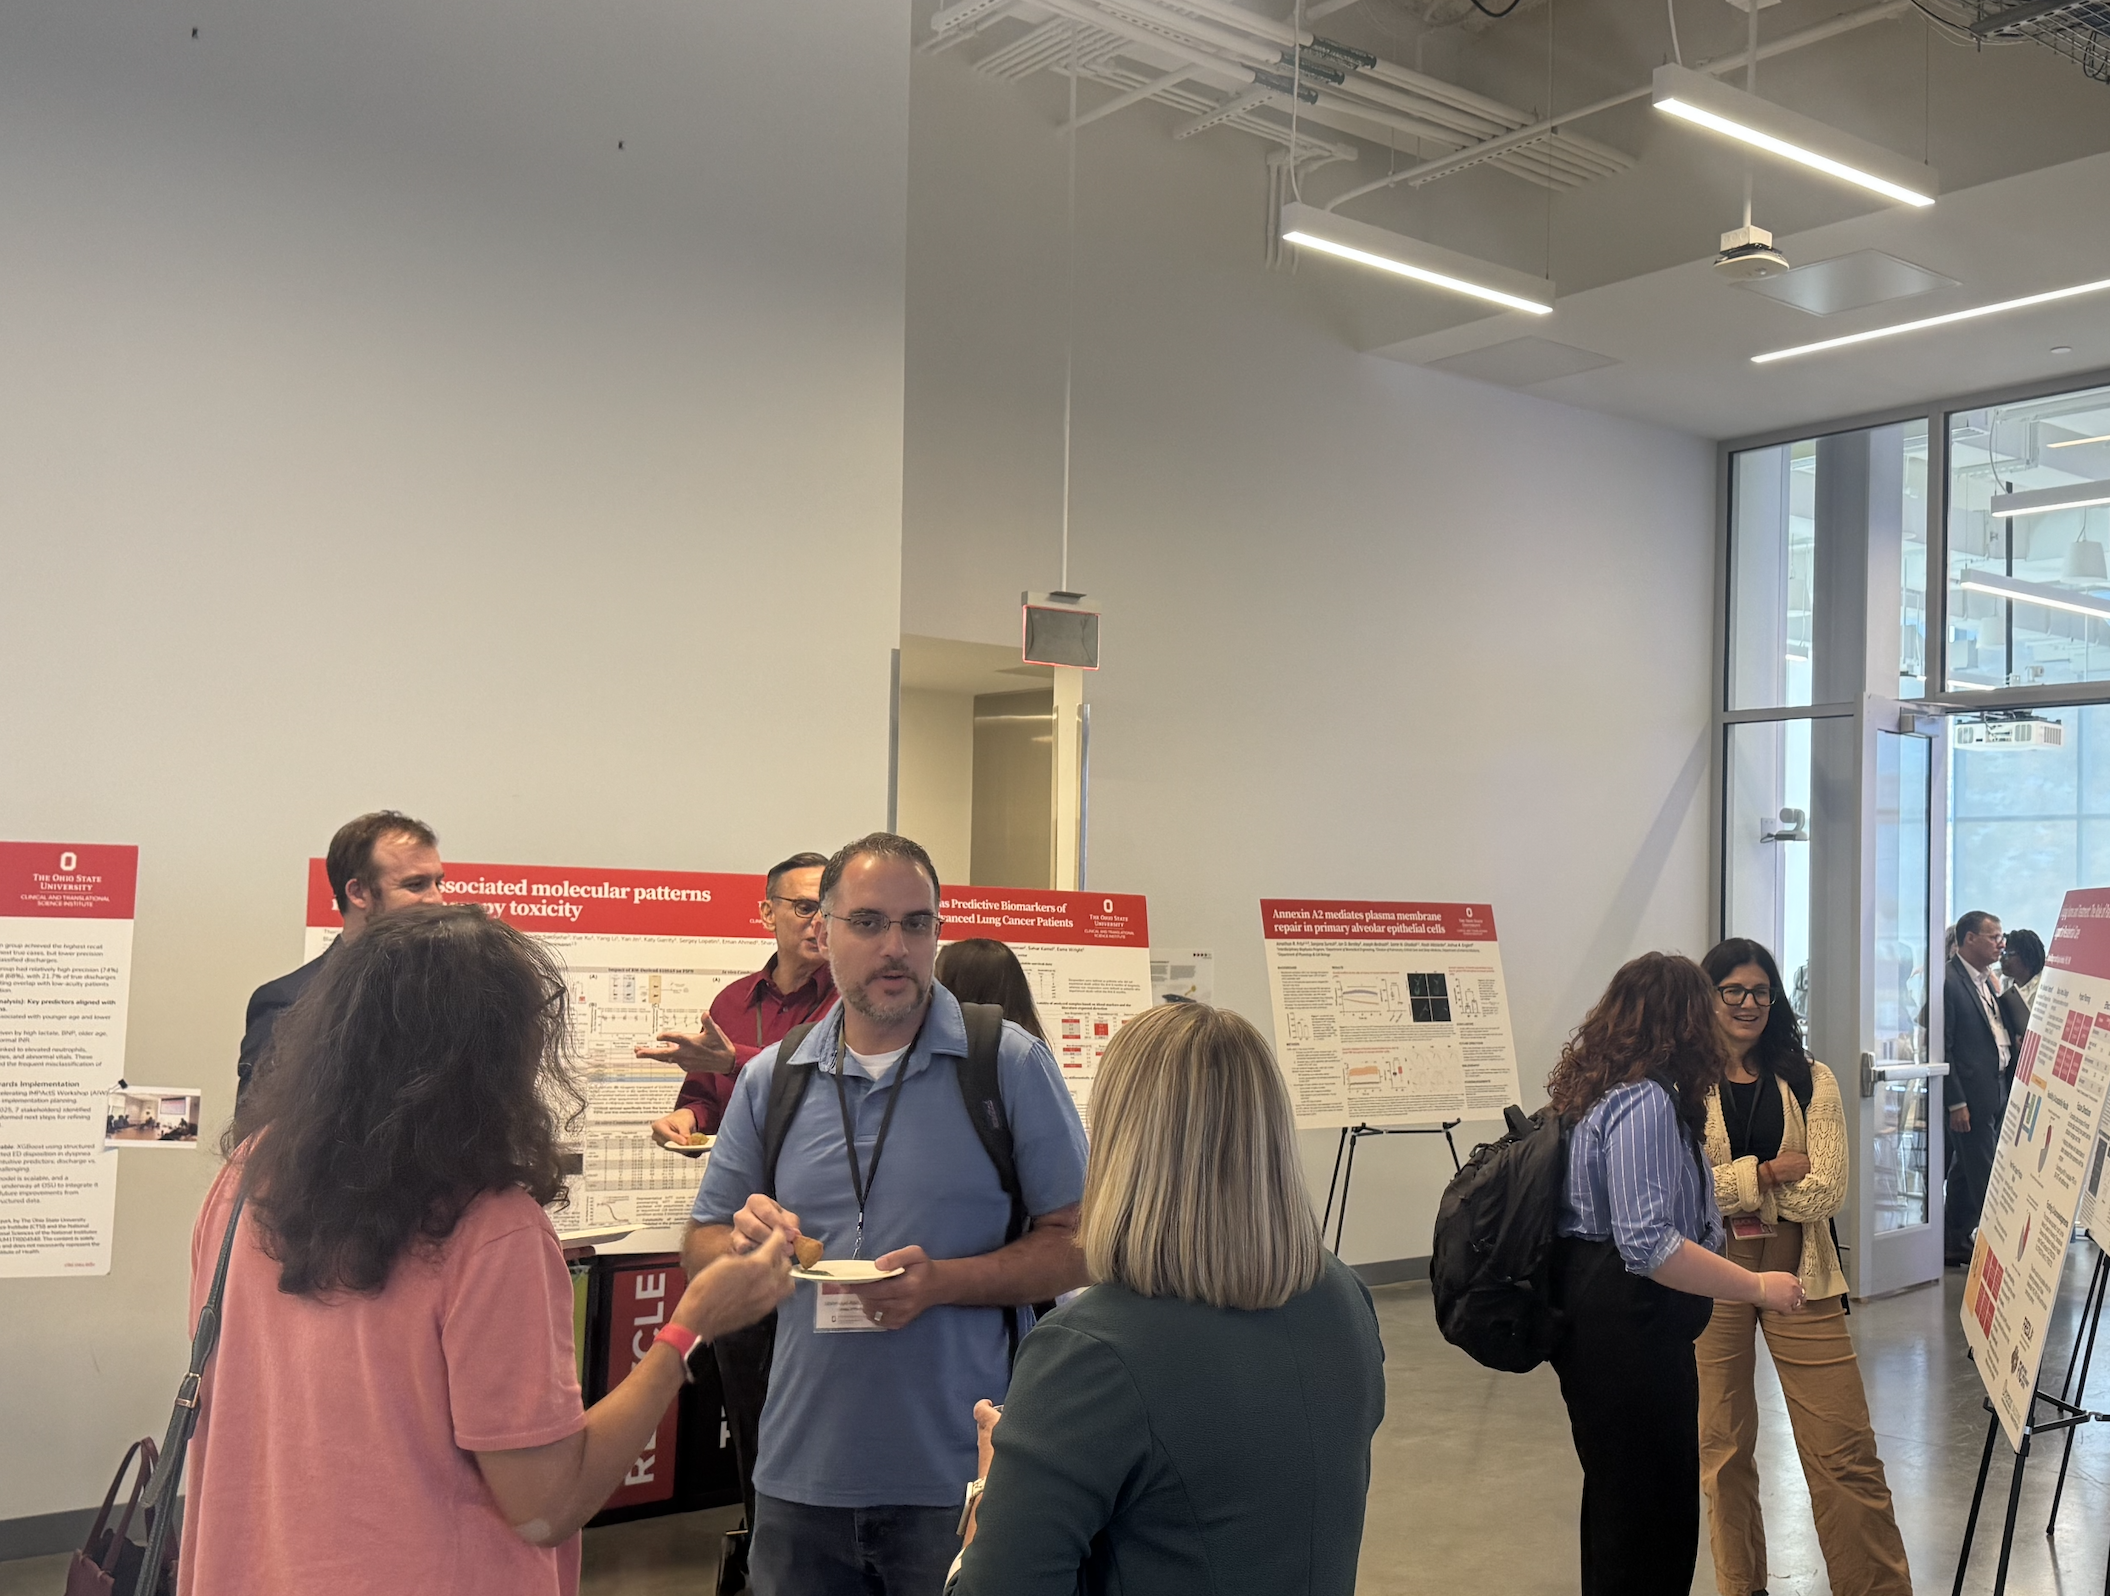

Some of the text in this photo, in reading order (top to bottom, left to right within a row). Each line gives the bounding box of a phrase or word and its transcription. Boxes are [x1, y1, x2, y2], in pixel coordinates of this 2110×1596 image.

[60, 852, 77, 871] O
[33, 873, 102, 883] THE OHIO STATE
[40, 882, 93, 891] UNIVERSITY
[439, 877, 711, 904] ssociated molecular patterns
[510, 899, 583, 922] toxicity
[939, 899, 1067, 913] as Predictive Biomarkers of
[1103, 899, 1114, 913] O
[976, 914, 1002, 927] Lung
[1002, 915, 1036, 926] Cancer
[1037, 917, 1074, 928] Patients
[1272, 908, 1442, 923] Annexin A2 mediates plasma membrane
[1274, 921, 1302, 935] repair
[1303, 922, 1313, 932] in
[1314, 922, 1350, 935] primary
[1351, 922, 1385, 933] alveolar
[1387, 923, 1426, 935] epithelial
[1427, 924, 1446, 934] cells
[624, 1273, 666, 1486] RCLE
